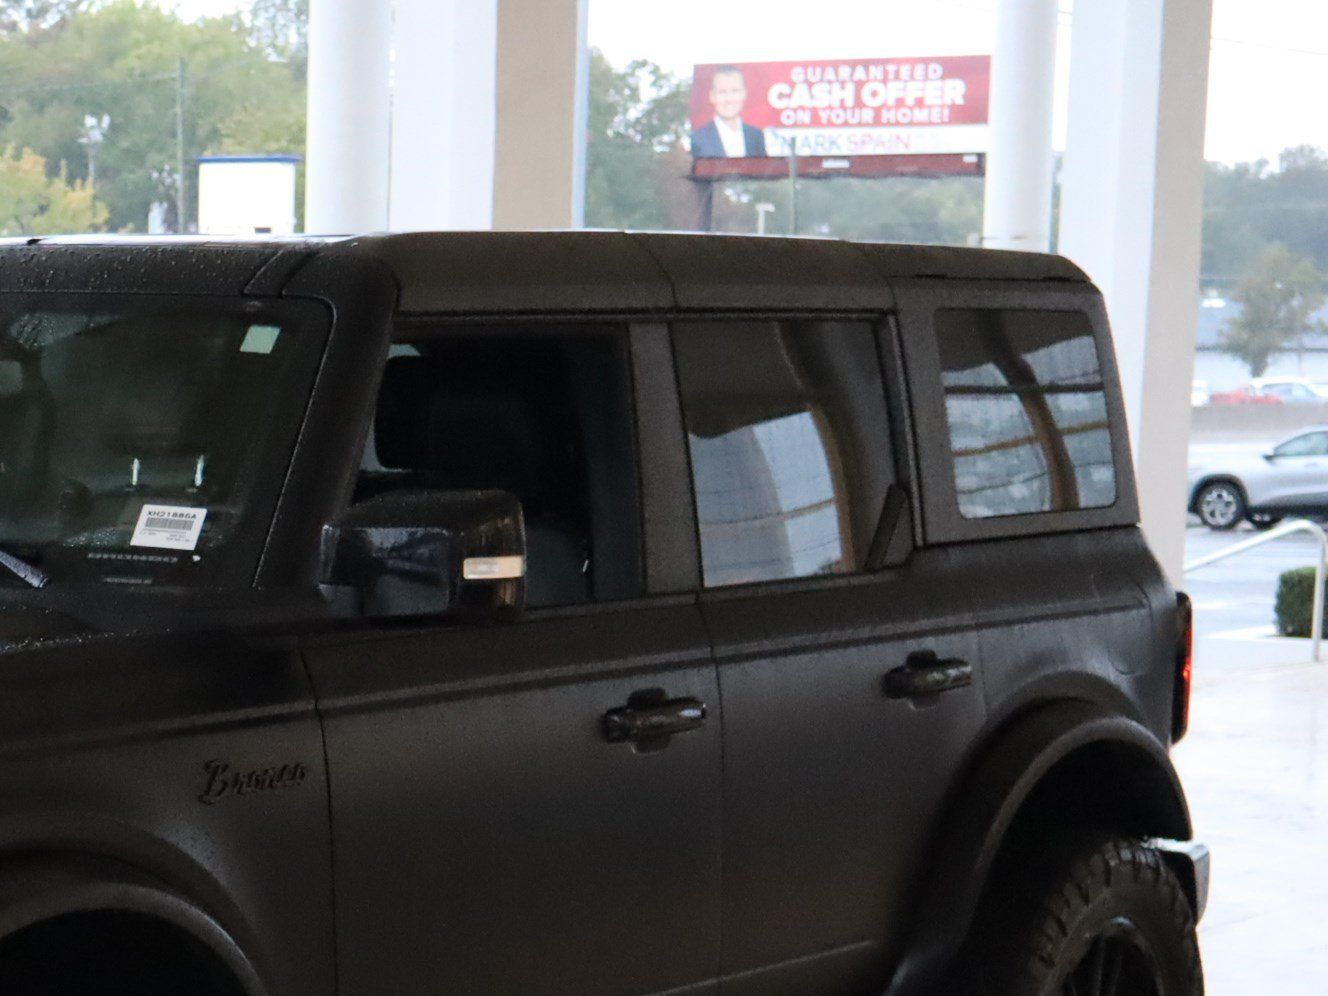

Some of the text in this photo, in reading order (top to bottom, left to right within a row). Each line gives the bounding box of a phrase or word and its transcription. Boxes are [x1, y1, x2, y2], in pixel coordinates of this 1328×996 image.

[791, 63, 943, 83] GUARANTEED
[767, 79, 967, 108] CASH OFFER
[780, 106, 950, 125] ON YOUR HOME!
[198, 759, 306, 806] Bronco
